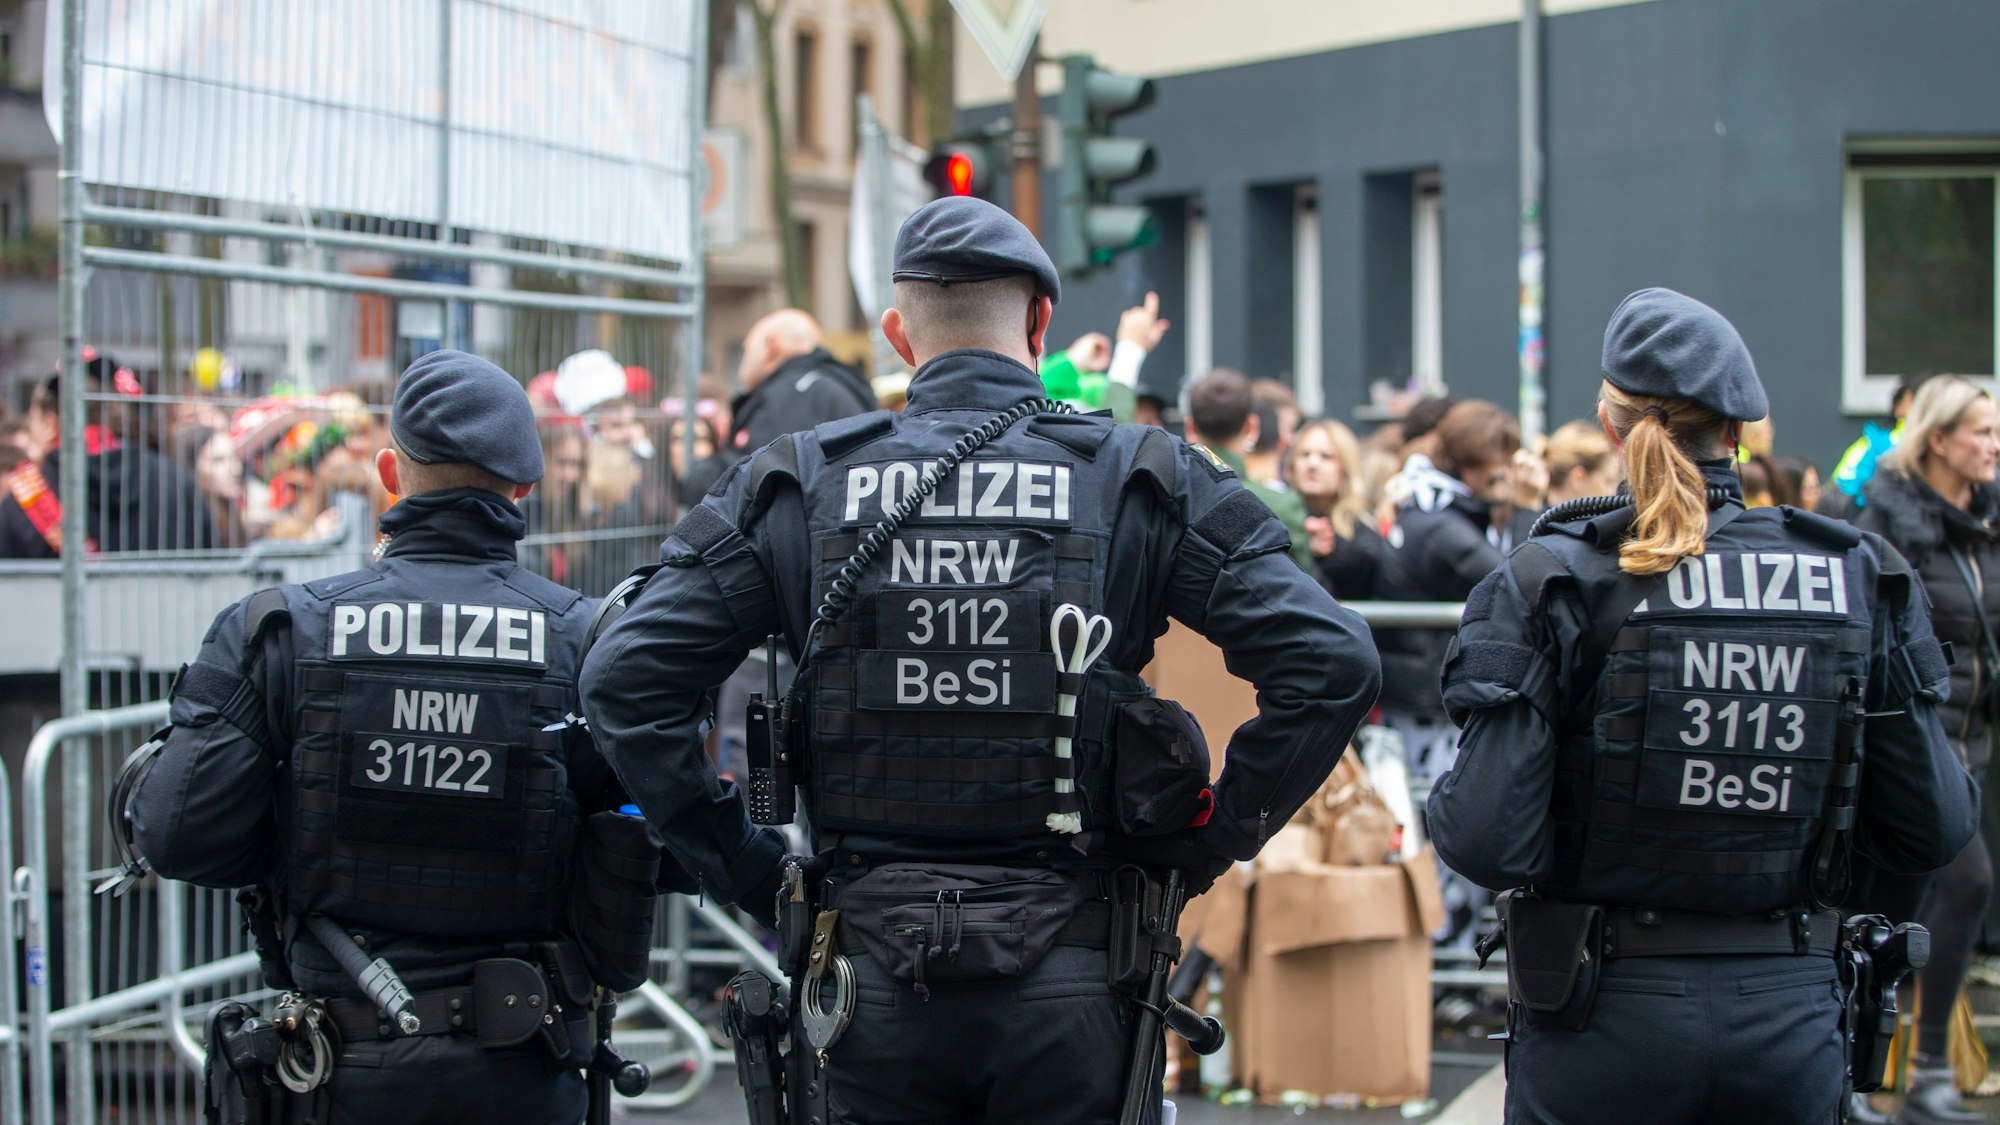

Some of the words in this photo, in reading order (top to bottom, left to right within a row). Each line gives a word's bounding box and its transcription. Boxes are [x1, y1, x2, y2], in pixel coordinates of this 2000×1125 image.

[844, 461, 1071, 521] POLIZEI
[890, 538, 1020, 585] NRW
[1633, 553, 1849, 615] OLIZEI
[332, 602, 546, 664] POLIZEI
[907, 598, 1009, 645] 3112
[896, 657, 1011, 705] BeSi
[1683, 640, 1806, 693] NRW
[392, 688, 479, 734] NRW
[1679, 698, 1805, 752] 3113
[366, 739, 492, 793] 31122
[1679, 759, 1792, 812] BeSi
